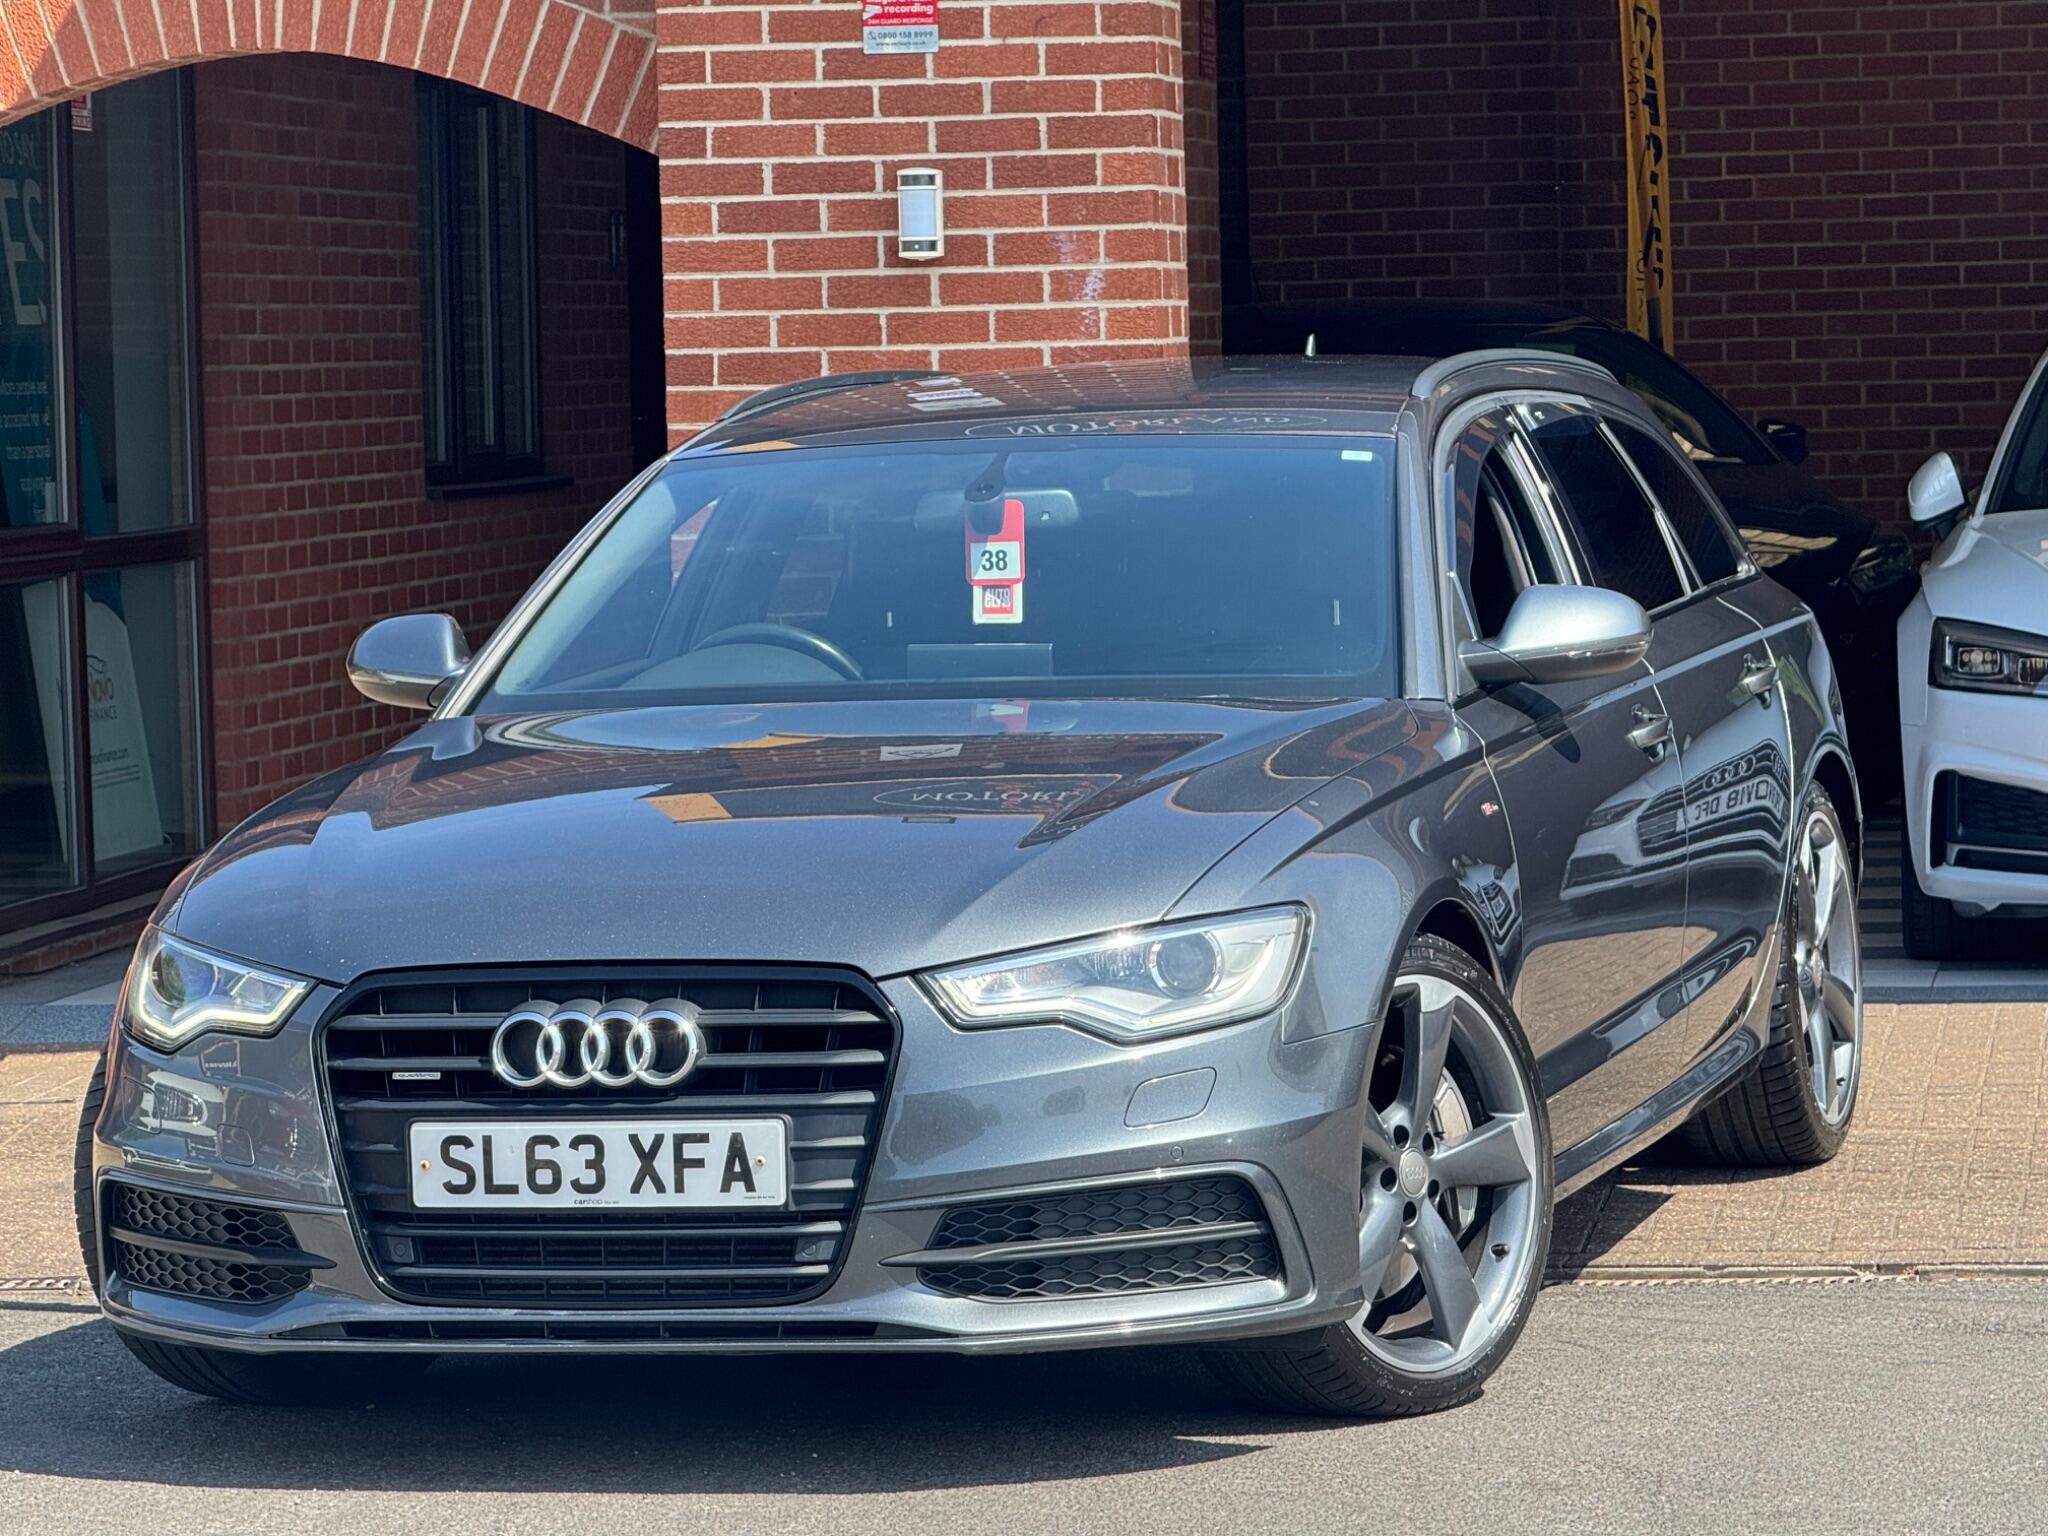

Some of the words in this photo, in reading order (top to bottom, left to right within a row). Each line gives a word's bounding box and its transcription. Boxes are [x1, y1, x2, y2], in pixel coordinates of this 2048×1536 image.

[884, 3, 934, 15] recording
[877, 31, 897, 39] 0800
[0, 177, 47, 325] ES
[981, 549, 1008, 571] 38
[439, 1134, 606, 1195] SL63
[628, 1132, 757, 1194] XFA
